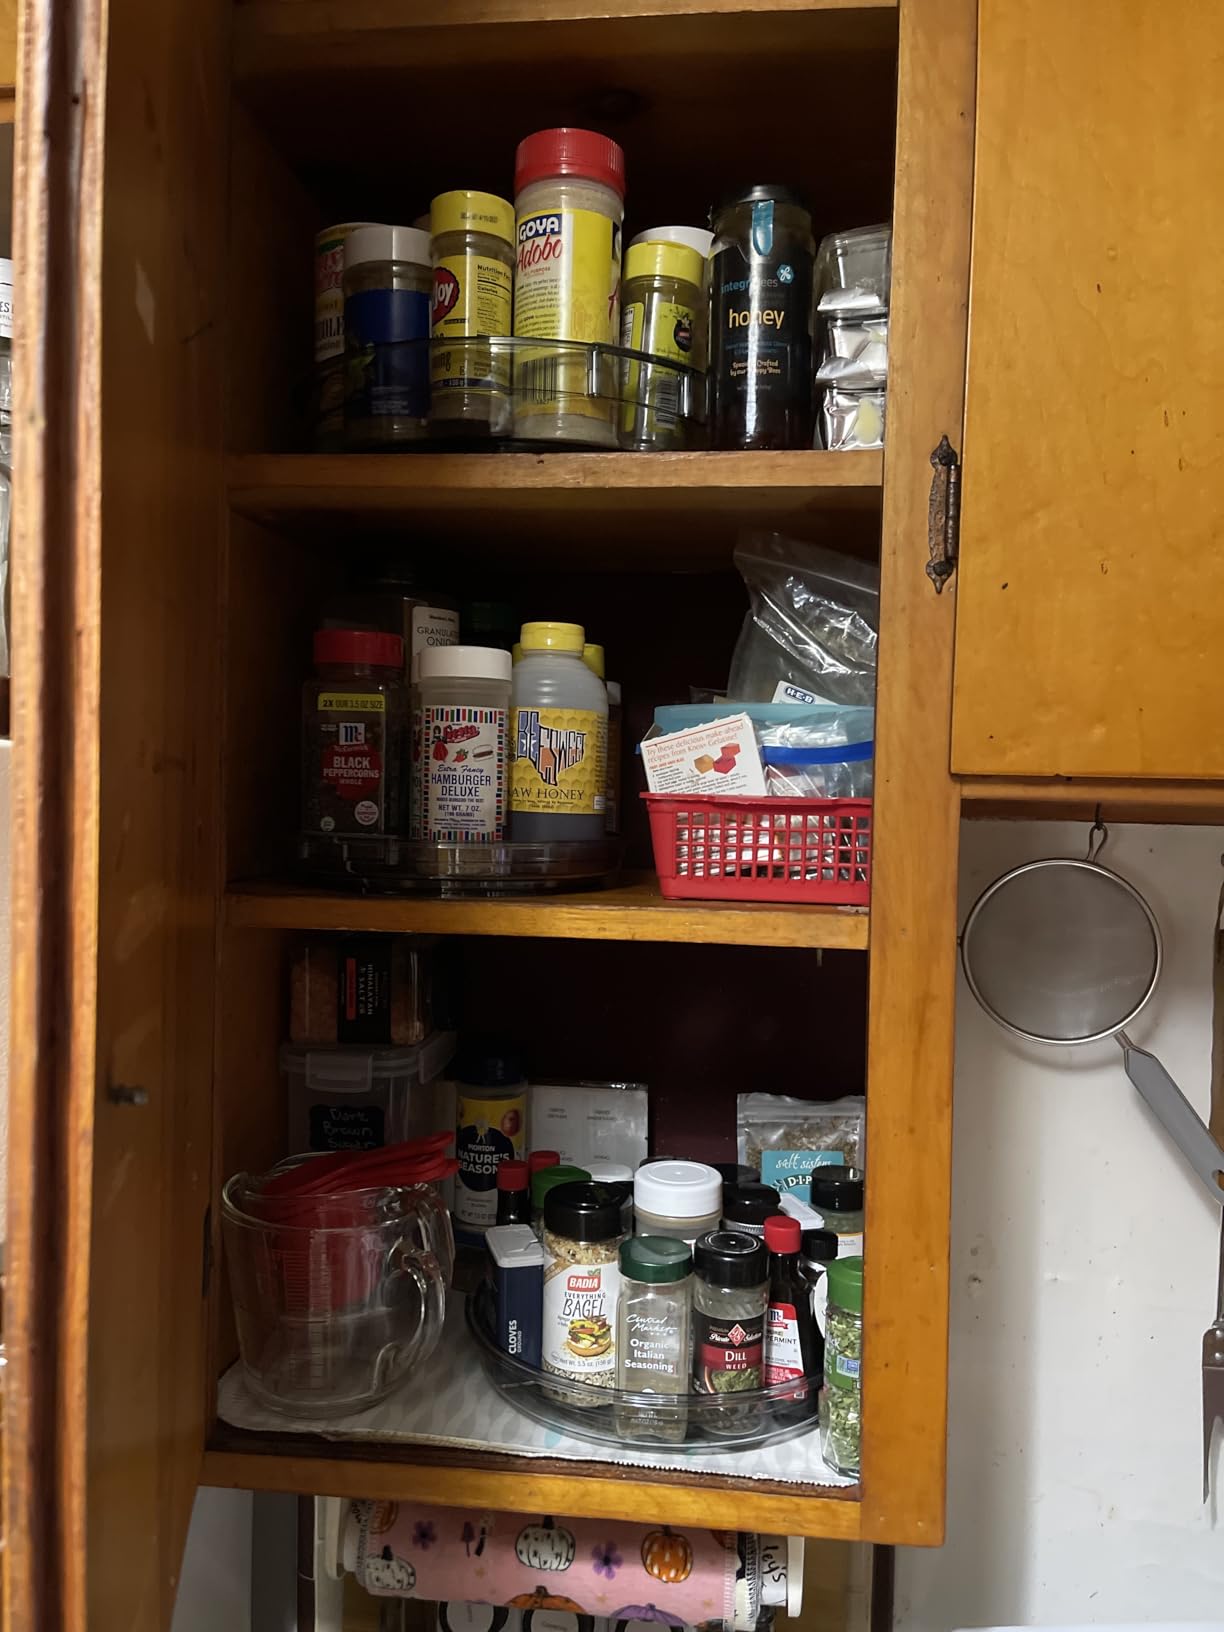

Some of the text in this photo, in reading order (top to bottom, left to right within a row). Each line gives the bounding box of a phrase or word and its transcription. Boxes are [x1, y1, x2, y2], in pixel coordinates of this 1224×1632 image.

[520, 216, 560, 241] GOYA
[517, 233, 563, 272] Adobo
[477, 264, 503, 275] Nutrition
[729, 308, 785, 330] honey
[333, 756, 371, 769] BLACK
[323, 768, 380, 778] PEPPERCORNS
[460, 764, 484, 774] Fancy
[431, 773, 491, 786] HAMBURGER
[441, 785, 480, 797] DELUXE
[512, 787, 584, 800] AW HONEY
[775, 1153, 800, 1169] salt
[459, 1160, 498, 1175] EASON
[569, 1277, 599, 1289] BADIA
[564, 1291, 606, 1300] EVERYTHING
[562, 1298, 607, 1318] BAGEL
[626, 1314, 668, 1324] Central
[630, 1321, 678, 1333] Market
[508, 1319, 517, 1354] CLOVES
[630, 1338, 670, 1350] Organic
[634, 1349, 665, 1360] Italian
[725, 1350, 748, 1362] DILL
[624, 1359, 673, 1373] Seasoning
